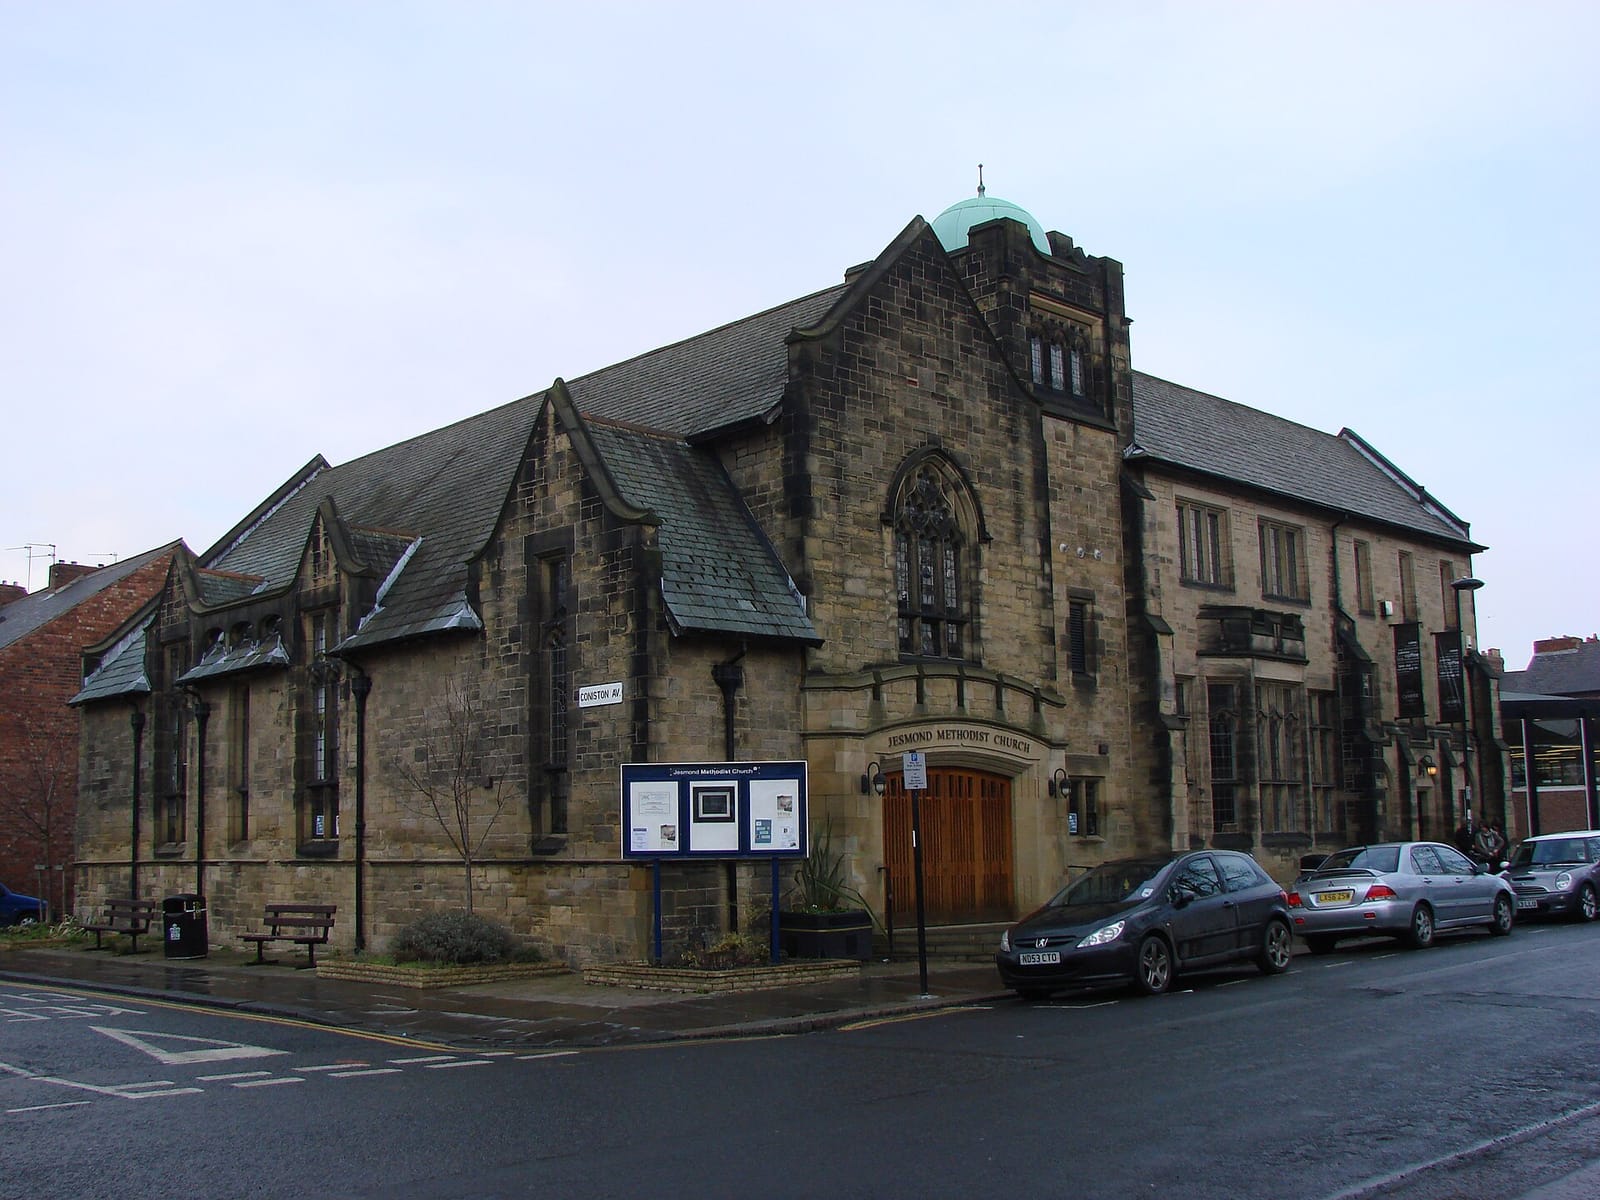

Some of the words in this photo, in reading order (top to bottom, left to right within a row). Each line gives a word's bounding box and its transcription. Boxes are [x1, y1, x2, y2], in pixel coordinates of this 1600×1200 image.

[888, 731, 933, 747] JESMOND
[937, 729, 990, 742] METHODIST
[993, 735, 1030, 753] CHURCH
